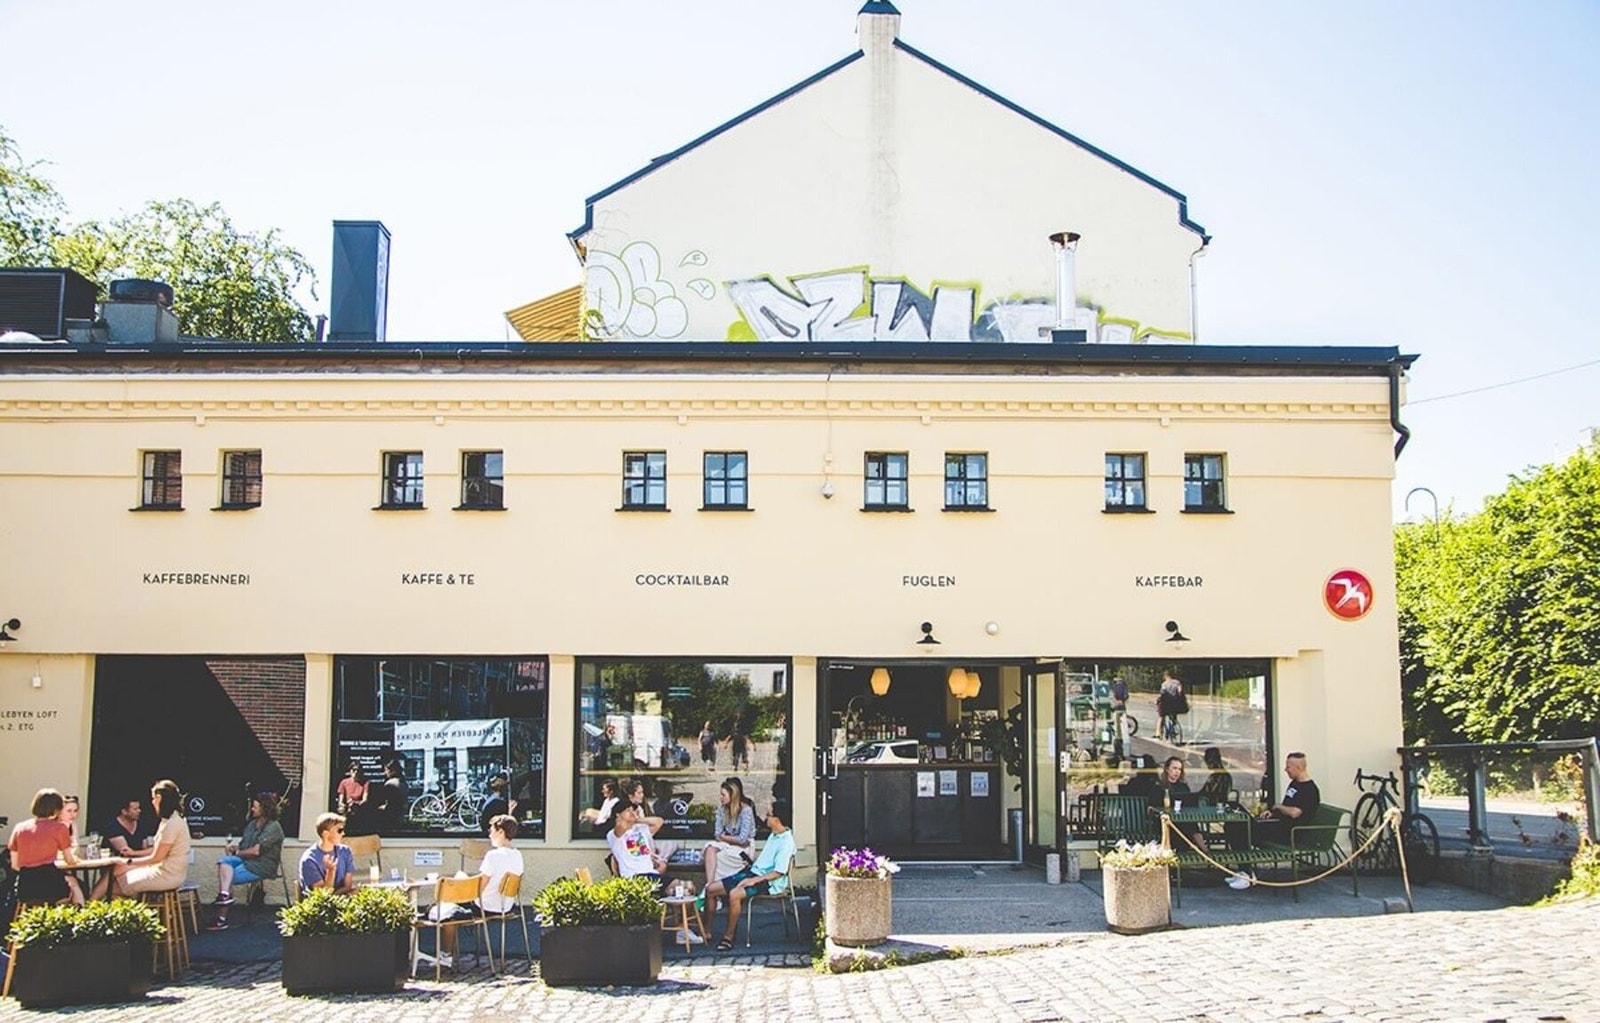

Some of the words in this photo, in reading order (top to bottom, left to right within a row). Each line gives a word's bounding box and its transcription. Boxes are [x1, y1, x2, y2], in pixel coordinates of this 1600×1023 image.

[143, 573, 250, 585] KAFFEBRENNERI
[402, 573, 443, 585] KAFFE
[446, 574, 455, 585] &
[459, 574, 475, 585] TE
[635, 574, 730, 586] COCKTAILBAR
[903, 575, 956, 587] FUGLEN
[1135, 575, 1204, 587] KAFFEBAR
[36, 710, 57, 718] LOFT
